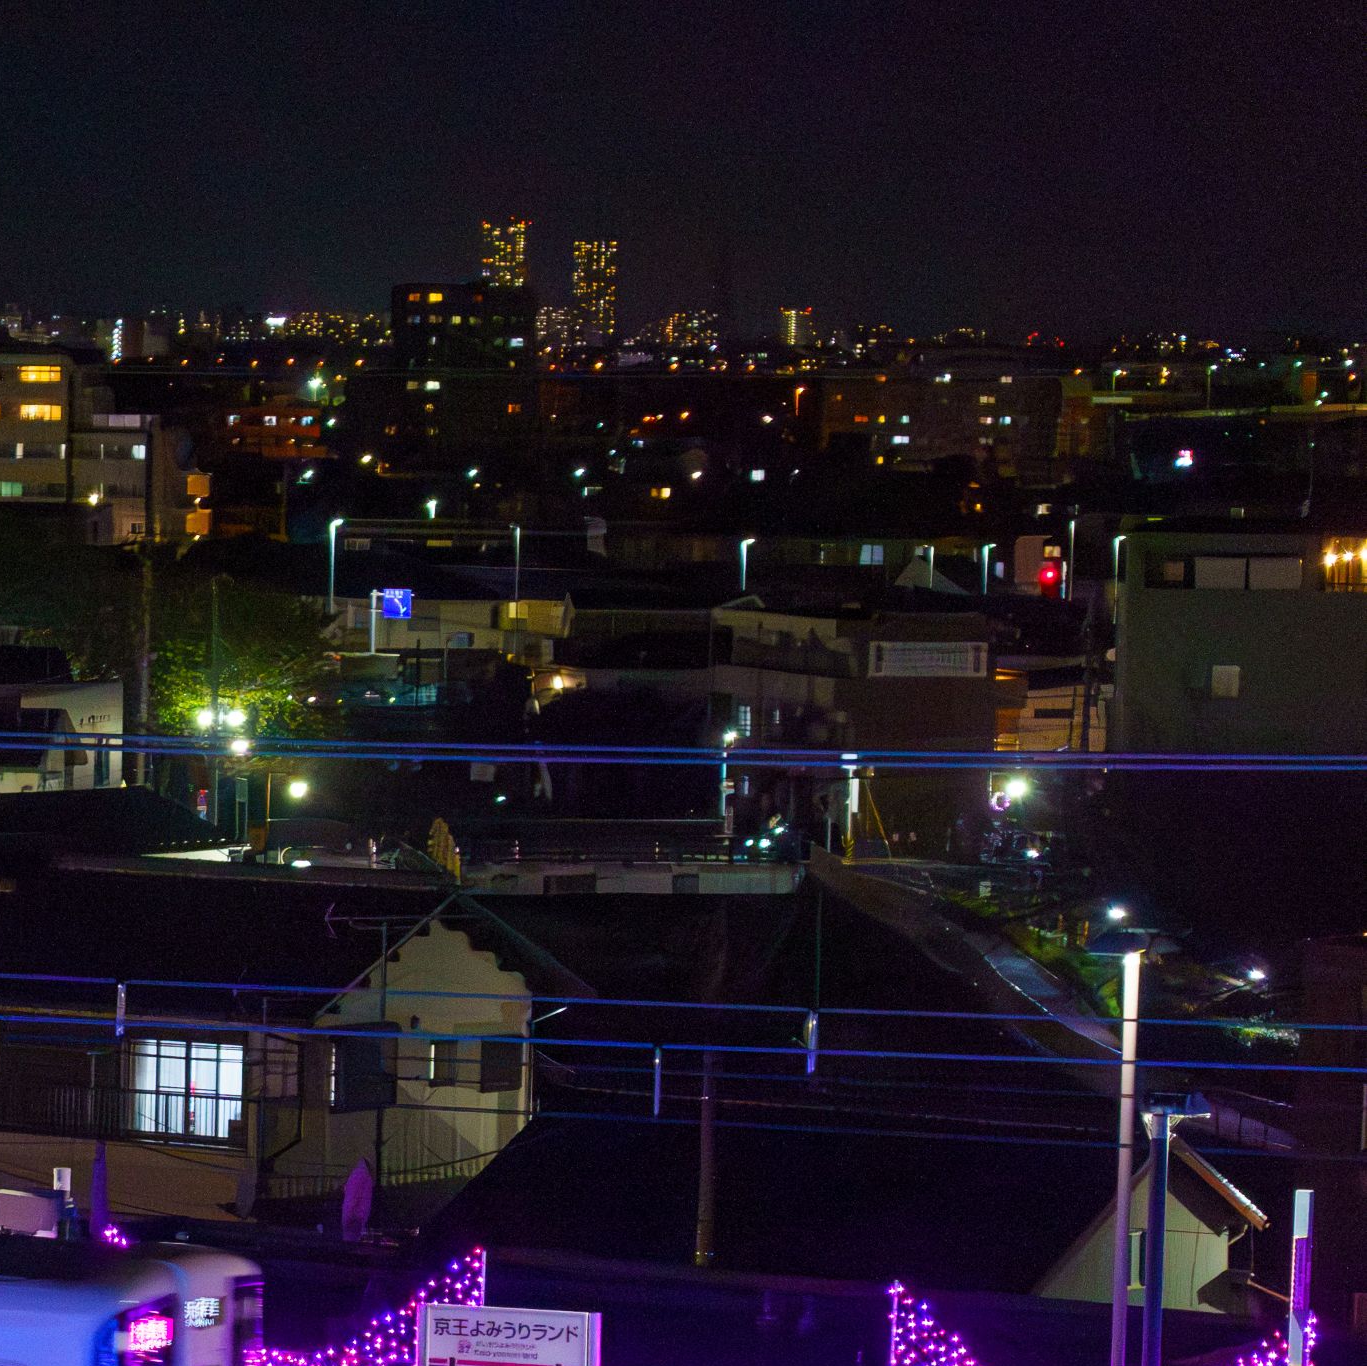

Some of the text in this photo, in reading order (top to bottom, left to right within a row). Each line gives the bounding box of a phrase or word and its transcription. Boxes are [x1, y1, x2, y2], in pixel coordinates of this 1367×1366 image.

[433, 1317, 579, 1343] 京王よみうりランド
